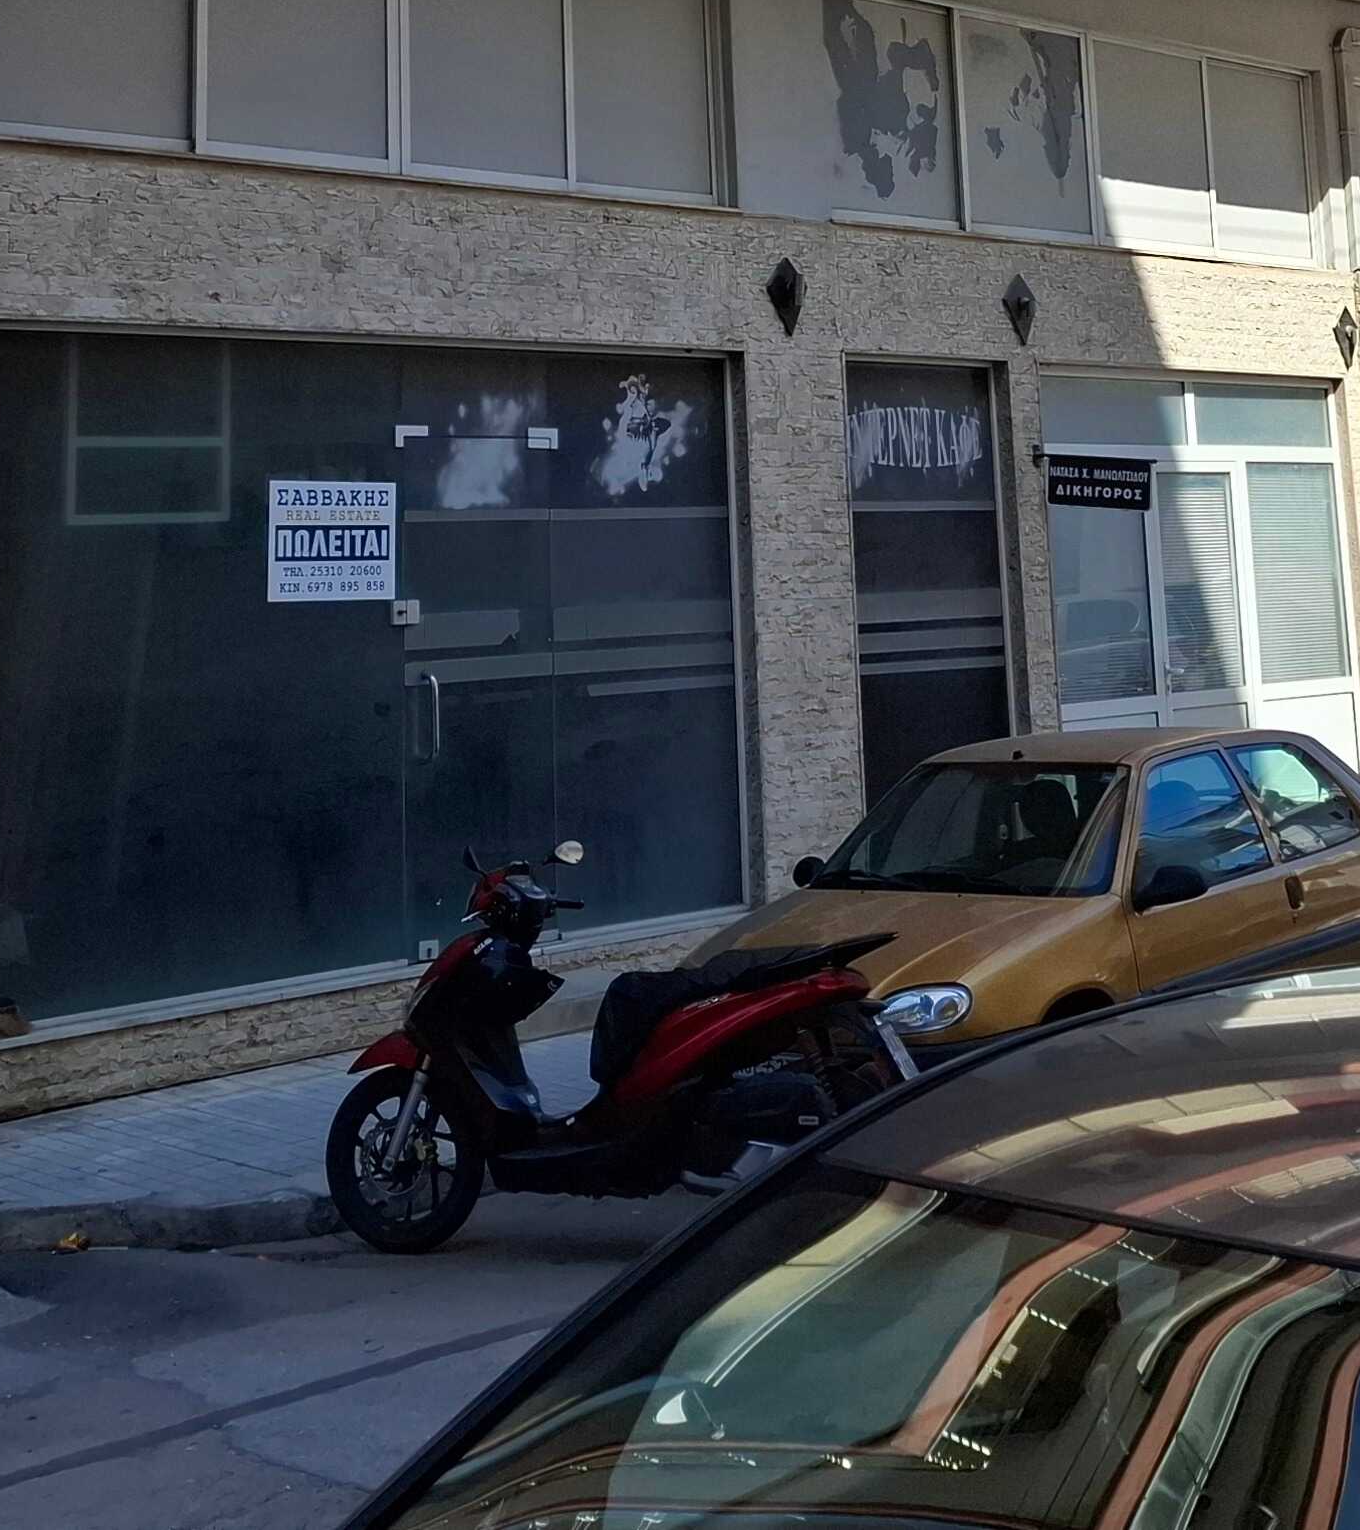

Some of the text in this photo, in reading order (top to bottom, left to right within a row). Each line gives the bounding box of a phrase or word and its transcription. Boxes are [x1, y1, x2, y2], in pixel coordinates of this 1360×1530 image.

[277, 489, 389, 507] ΣΑΒΒΑΚΗΣ
[1056, 484, 1142, 501] ΔΙΚΗΓΟΡΟΣ
[286, 510, 381, 521] REAL ESTATE
[276, 529, 389, 558] ΠΩΛΕΙΤΑΙ
[350, 565, 383, 576] 20600
[340, 581, 359, 591] 895
[366, 581, 385, 591] 858
